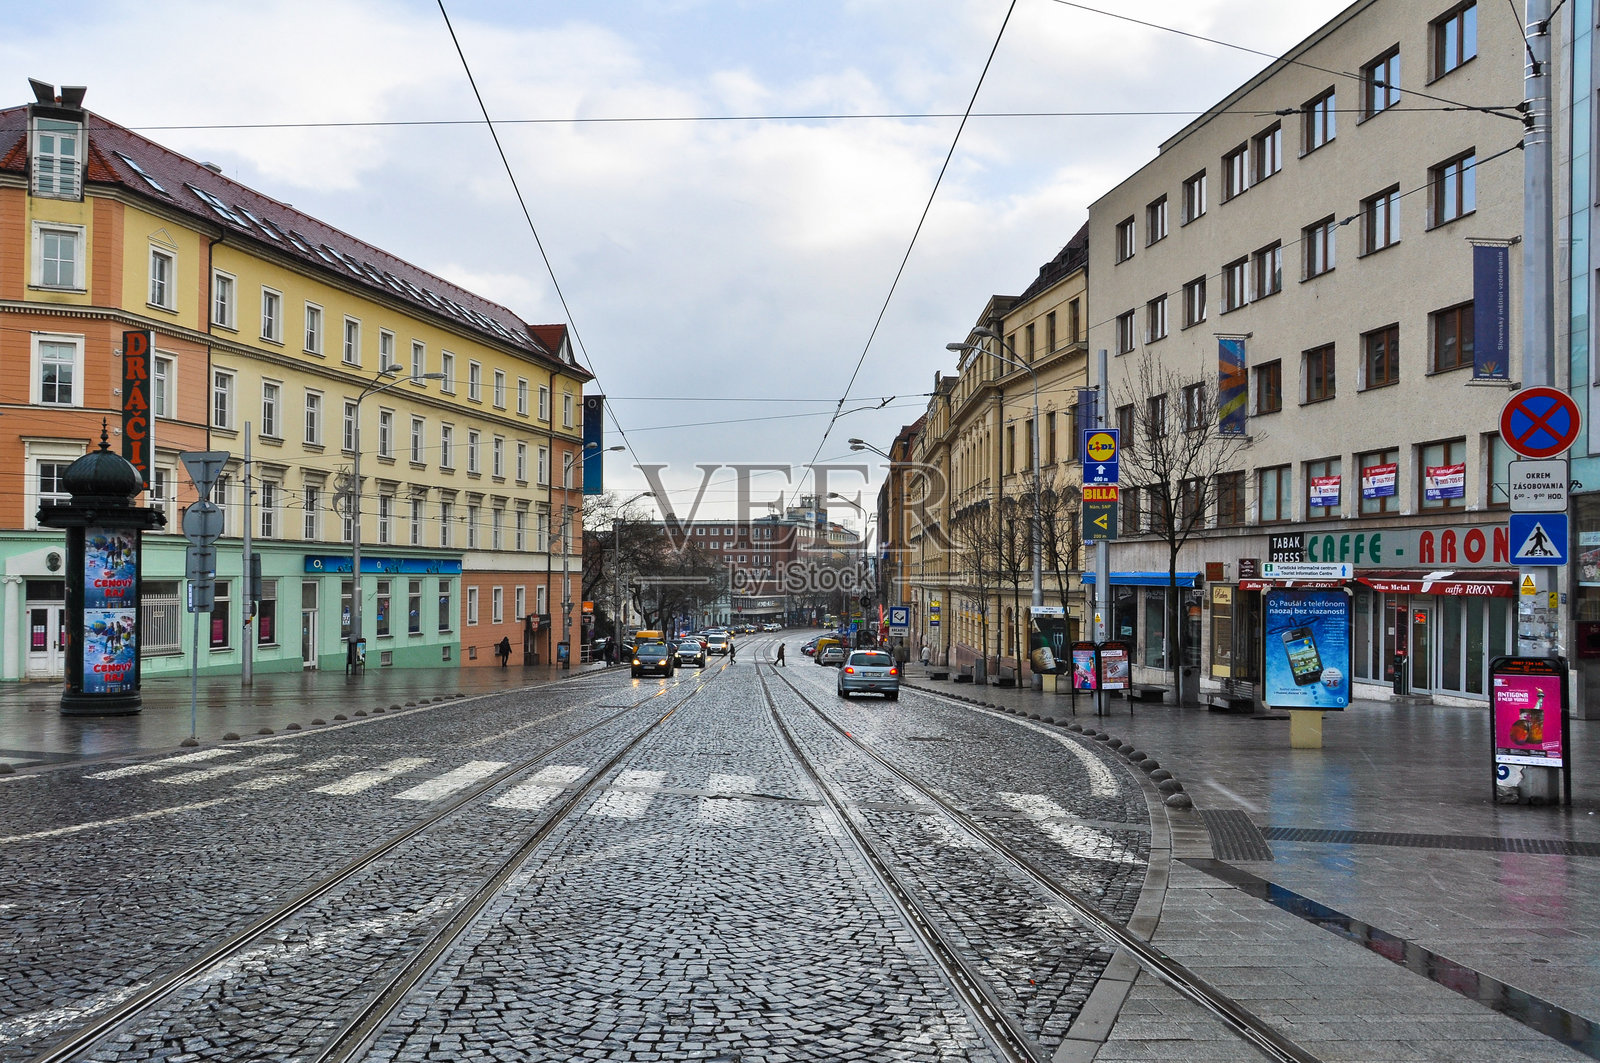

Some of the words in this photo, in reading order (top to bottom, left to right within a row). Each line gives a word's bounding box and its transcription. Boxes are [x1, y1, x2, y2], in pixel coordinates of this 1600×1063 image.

[124, 332, 148, 489] DRÁČI
[1525, 472, 1551, 480] OKREM
[1512, 481, 1564, 490] ZÁSOBOVANIA
[1083, 488, 1117, 500] BILLA
[1547, 493, 1564, 501] HOD.
[1272, 536, 1301, 549] TABAK
[1308, 533, 1381, 564] CAFFE
[1419, 527, 1510, 564] RRON
[1273, 552, 1300, 563] PRESS
[93, 575, 133, 588] CENOVÝ
[1390, 583, 1410, 591] Meinl
[104, 587, 125, 598] RAJ
[1444, 584, 1463, 596] caffe
[1465, 584, 1495, 595] RRON
[1269, 608, 1293, 616] naozaj
[1308, 607, 1346, 615] viazanosti
[93, 659, 132, 673] CENOVÝ
[103, 673, 125, 683] RAJ
